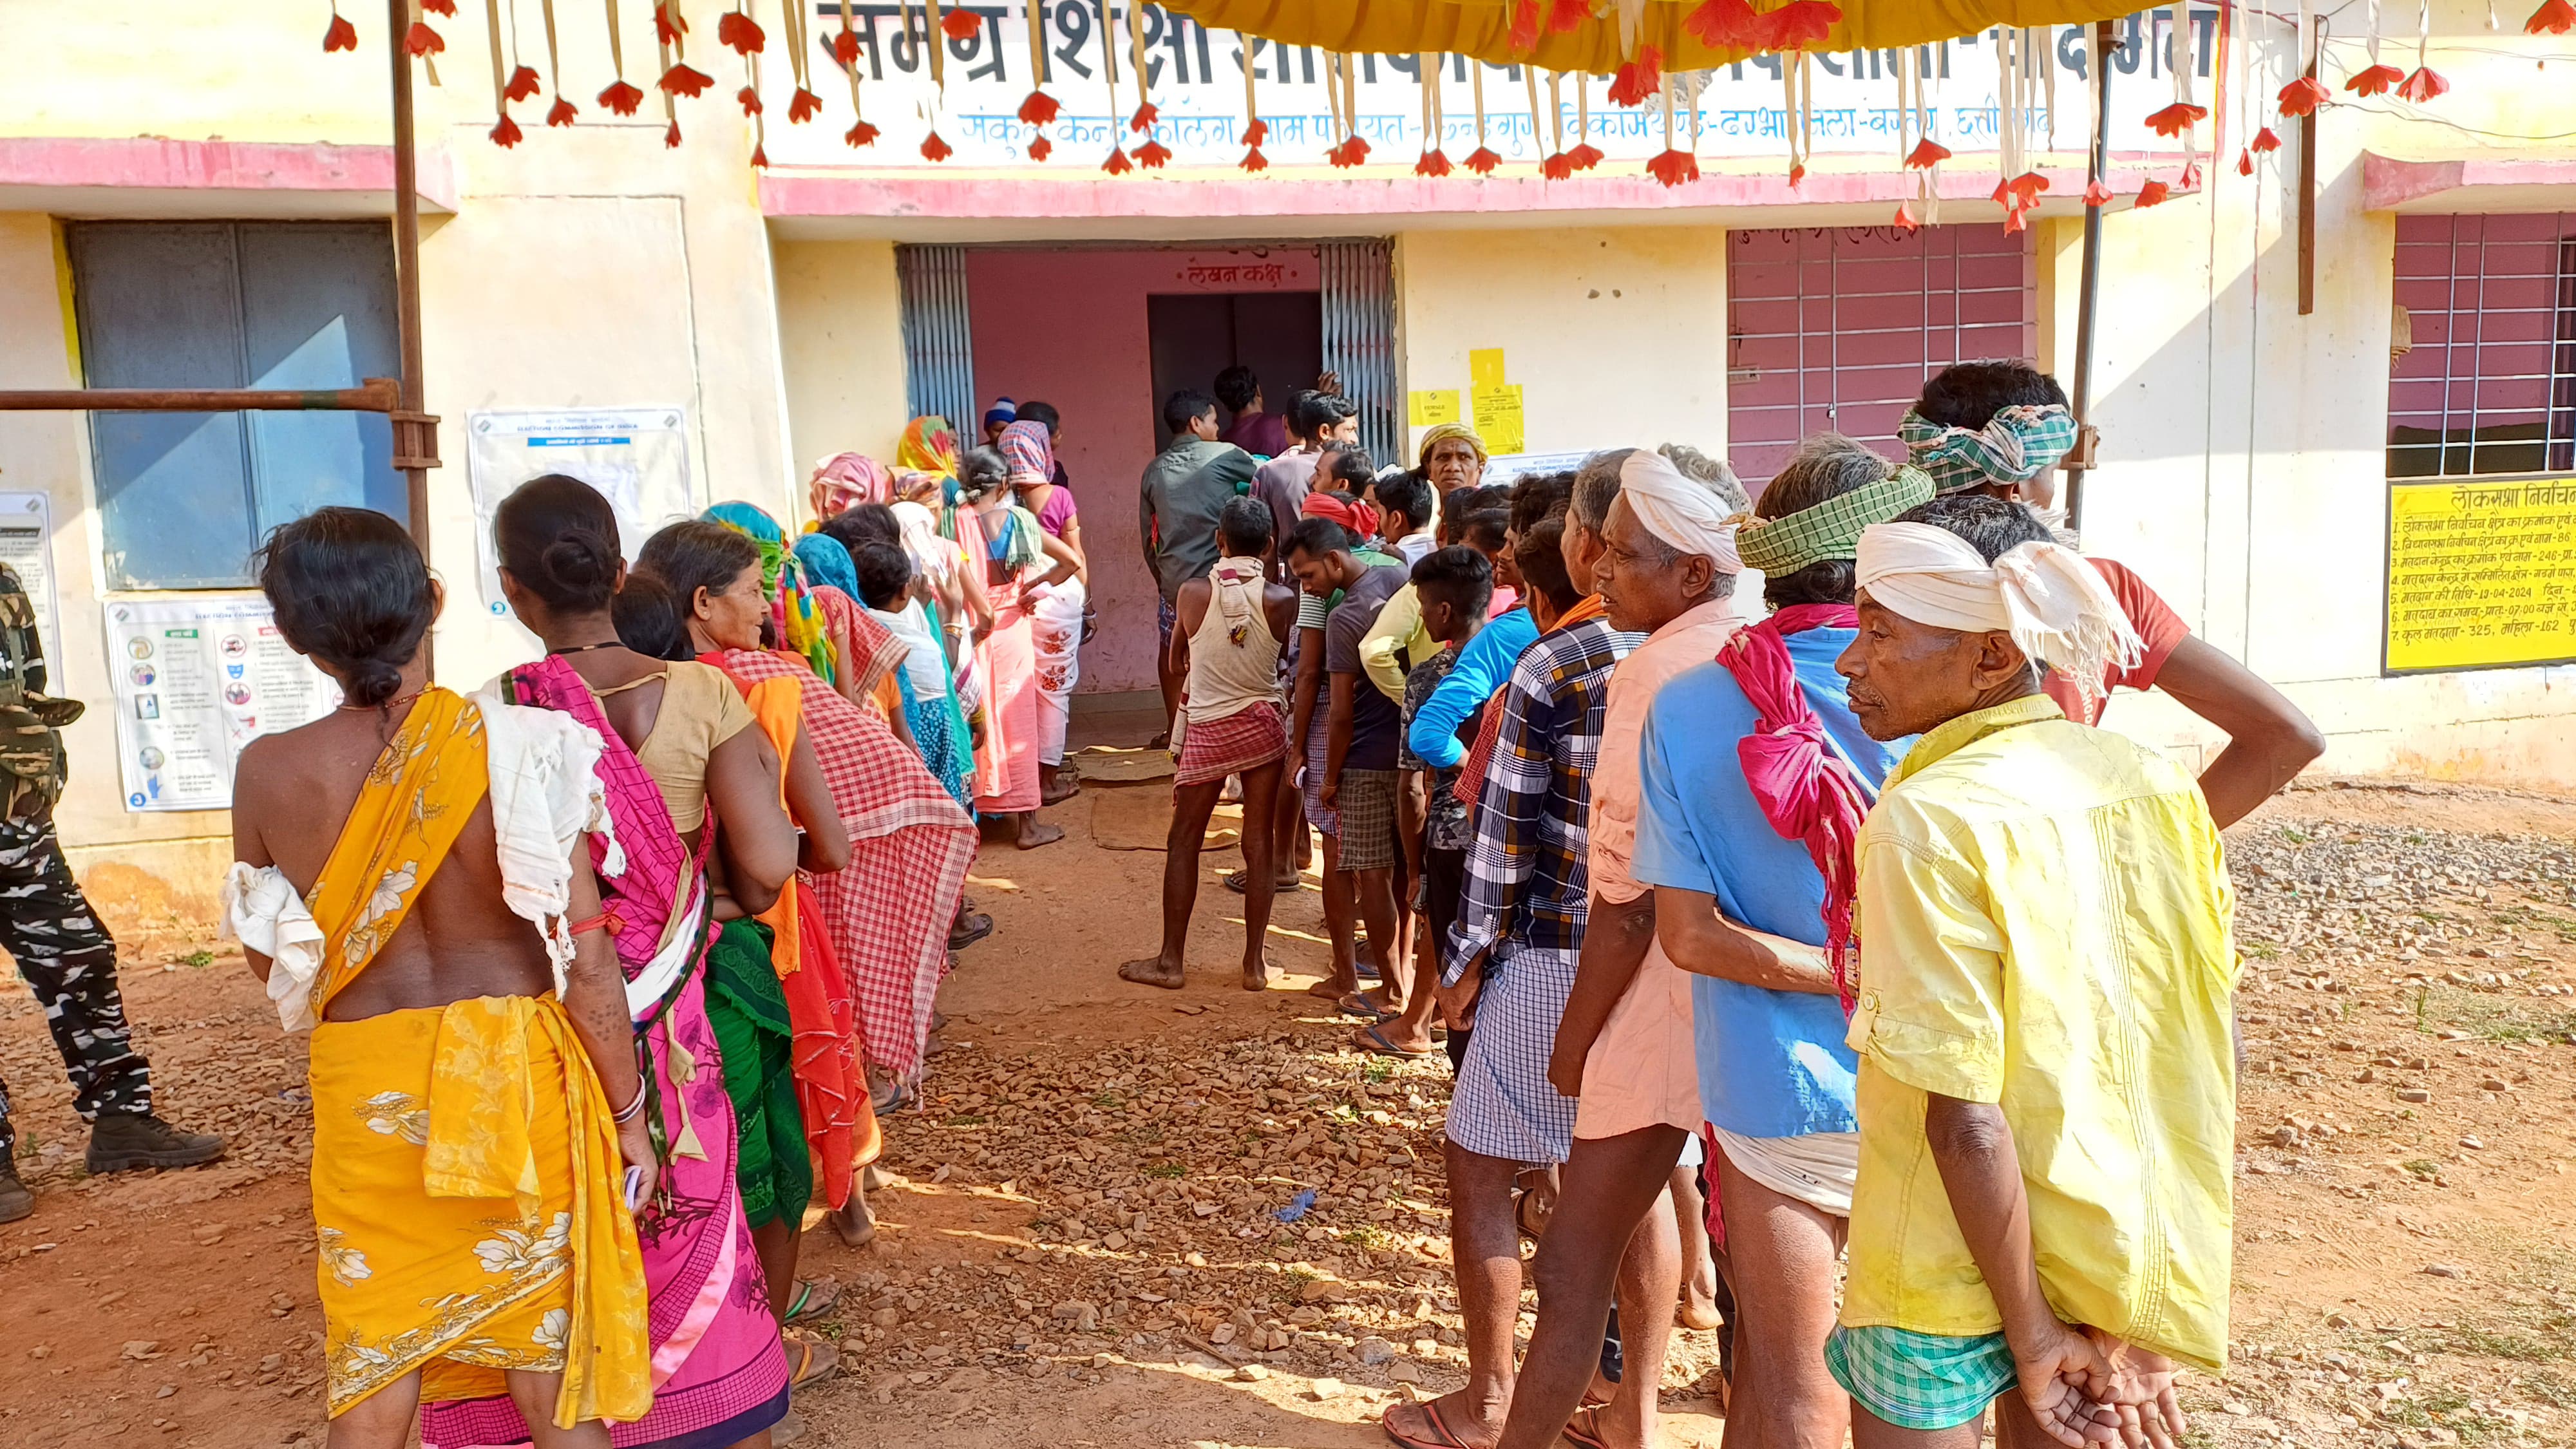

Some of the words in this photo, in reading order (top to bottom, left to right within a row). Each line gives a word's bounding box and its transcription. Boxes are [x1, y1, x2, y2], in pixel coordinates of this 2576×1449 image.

[817, 3, 1008, 82] समग्र
[1022, 0, 1213, 90] शिक्षा
[1187, 256, 1240, 290] लेखन
[1242, 263, 1285, 288] कक्ष
[2451, 486, 2521, 515] लोकसभा
[2403, 515, 2445, 537] लोकसभा
[2447, 513, 2486, 530] निर्वाचन
[2488, 511, 2506, 535] क्षेत्र
[2506, 517, 2522, 527] का
[2521, 513, 2555, 529] क्रमांक
[2556, 511, 2572, 529] एवं
[2402, 536, 2446, 551] विधानसभा
[2447, 531, 2478, 547] निर्वाचन
[2519, 532, 2533, 548] एवं
[2400, 556, 2430, 569] मतदान
[2430, 552, 2456, 568] केन्द्र
[2452, 556, 2467, 566] का
[2465, 551, 2497, 566] क्रमांक
[2499, 549, 2512, 568] एवं
[2401, 574, 2435, 589] मतदान
[2435, 568, 2464, 585] केन्द्र
[2461, 567, 2472, 582] में
[2471, 567, 2512, 585] सम्मिलित
[2401, 591, 2434, 604] मतदान
[2434, 586, 2450, 600] की
[2403, 609, 2437, 625] मतदान
[2438, 608, 2453, 618] का
[2536, 597, 2556, 614] बजे
[2401, 629, 2423, 647] कुल
[2501, 618, 2535, 638] महिला
